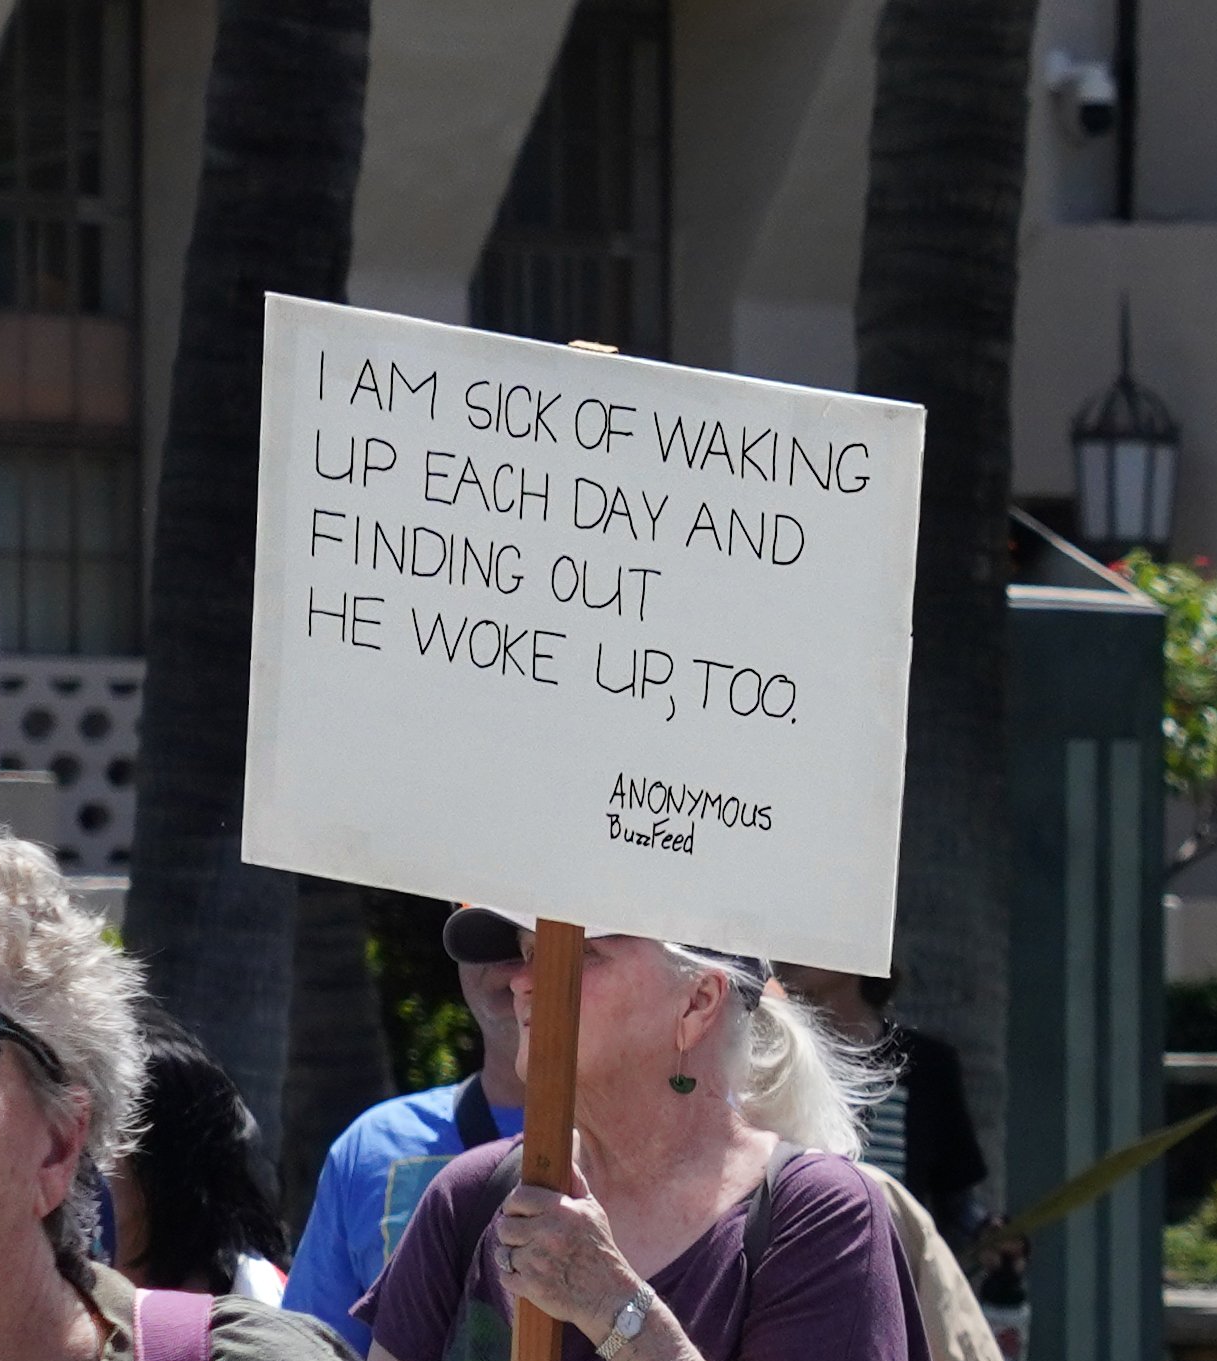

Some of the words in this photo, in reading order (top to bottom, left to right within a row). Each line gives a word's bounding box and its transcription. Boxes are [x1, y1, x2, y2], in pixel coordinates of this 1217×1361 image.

[318, 350, 325, 401] I
[350, 358, 437, 421] AM
[465, 380, 562, 444] SICK
[574, 398, 637, 454] OF
[653, 411, 871, 494] WAKING
[315, 429, 397, 488] UP
[424, 450, 549, 522] EACH
[574, 477, 669, 542] DAY
[685, 502, 805, 566] AND
[311, 508, 525, 595] FINDING
[551, 554, 662, 622] OUT
[308, 586, 385, 651] HE
[411, 607, 567, 686] WOKE
[596, 642, 676, 722] UP,
[692, 659, 797, 725] TOO.
[606, 813, 695, 856] BuzzFeed
[609, 772, 772, 831] ANONYMOUS
